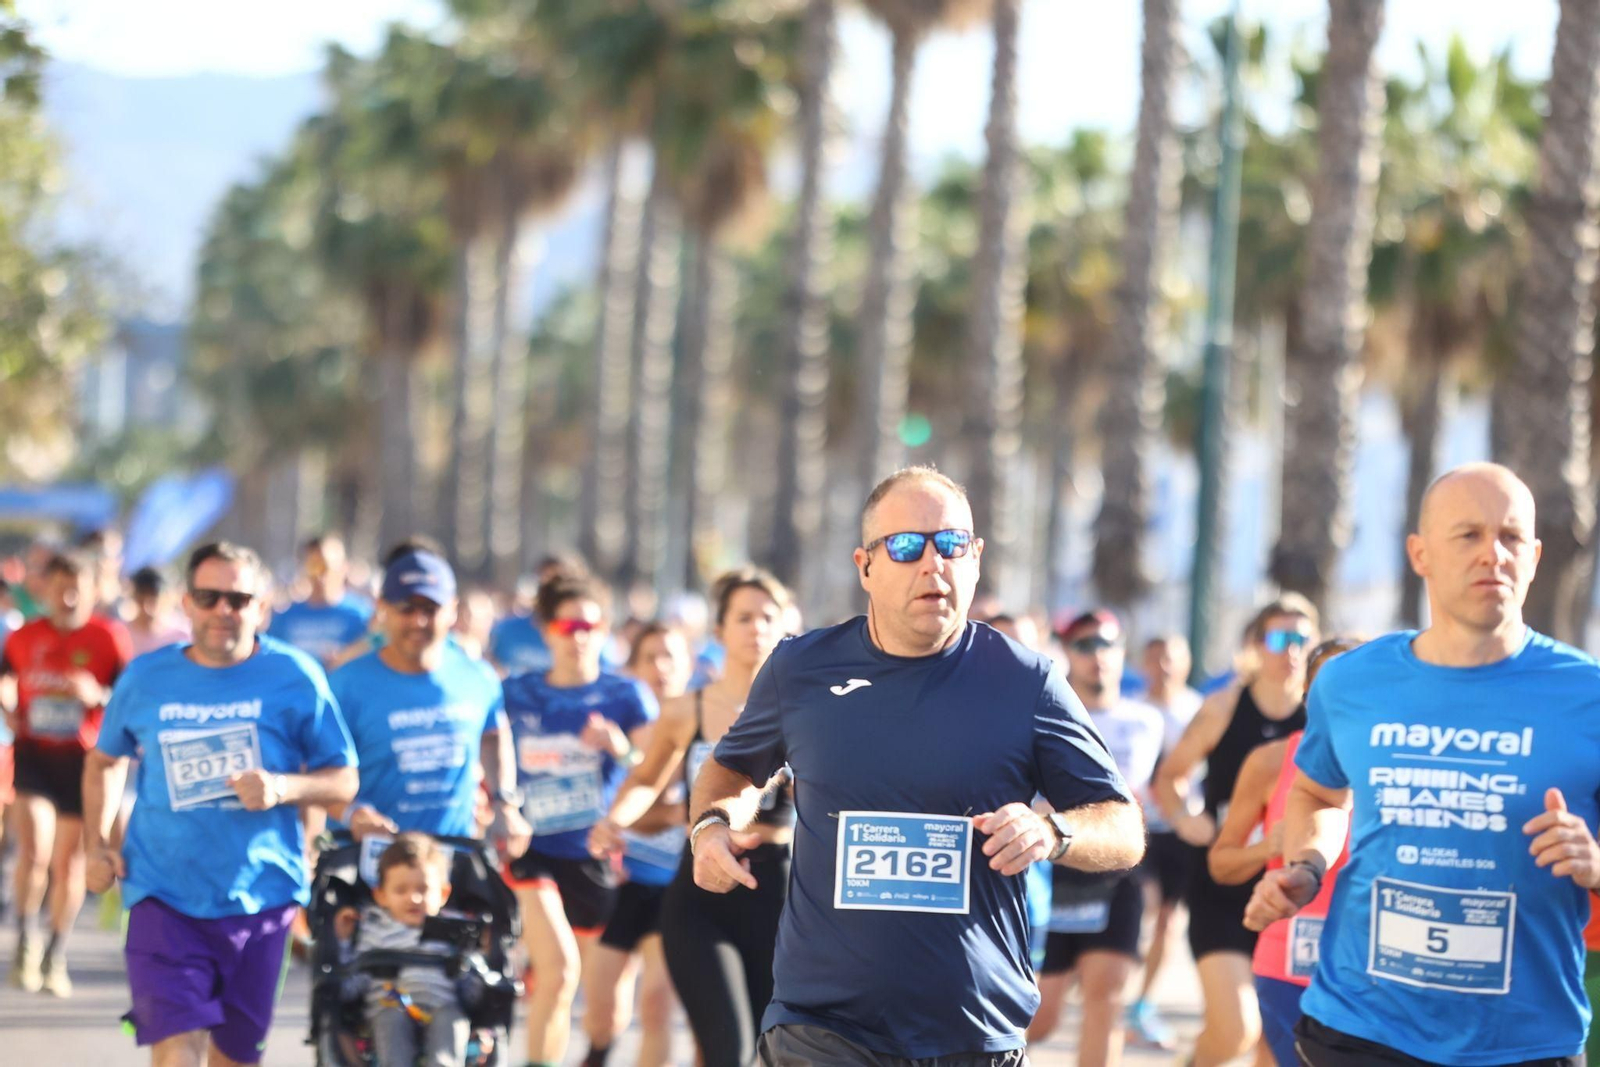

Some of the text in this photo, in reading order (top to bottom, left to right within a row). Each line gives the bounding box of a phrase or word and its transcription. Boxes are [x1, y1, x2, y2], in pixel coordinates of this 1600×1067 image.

[159, 698, 262, 723] mayoral
[1369, 722, 1533, 757] mayoral
[181, 753, 247, 781] 2073
[1368, 767, 1518, 795] RUNNING
[1382, 787, 1504, 813] MAKES
[863, 823, 900, 836] Carrera
[924, 822, 964, 833] mayoral
[1380, 807, 1507, 832] FRIENDS
[862, 832, 907, 844] Solidaria
[855, 849, 953, 879] 2162
[1460, 898, 1507, 909] mayoral
[1426, 926, 1449, 954] 5
